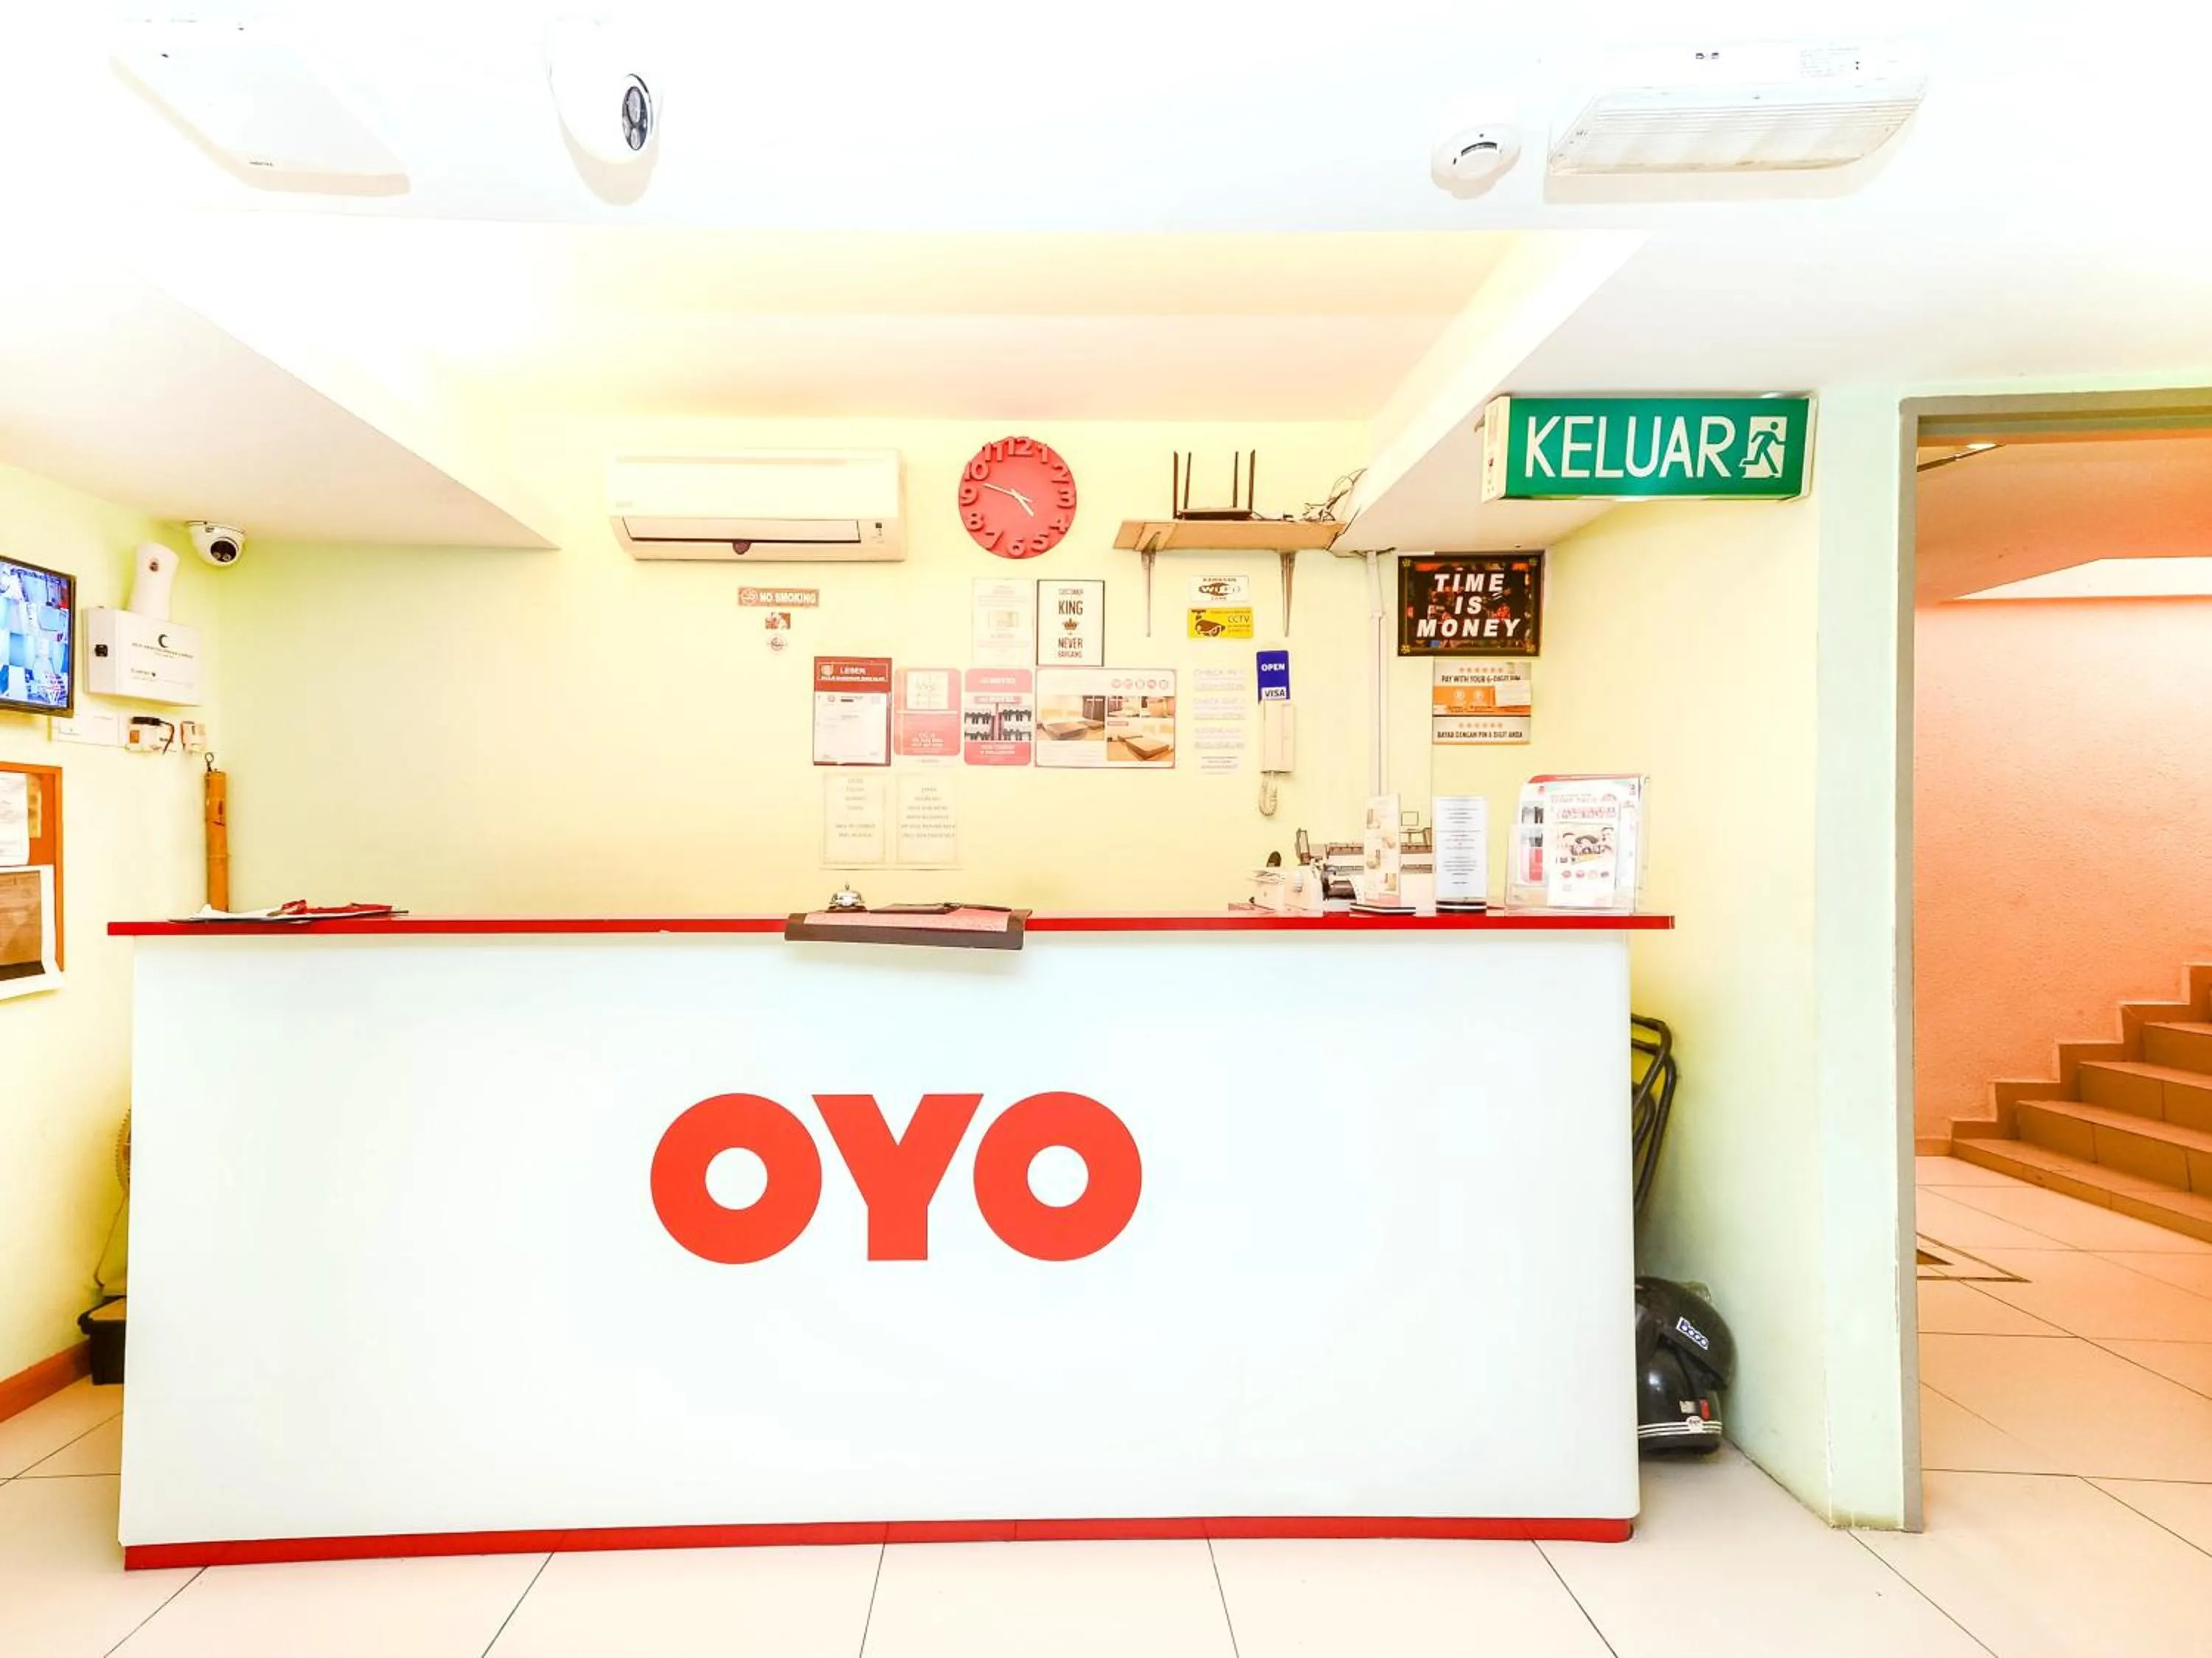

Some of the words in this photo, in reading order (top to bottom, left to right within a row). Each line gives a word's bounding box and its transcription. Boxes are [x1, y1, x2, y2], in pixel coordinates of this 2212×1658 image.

[983, 442, 1004, 462] 11
[1005, 437, 1033, 457] 12
[1525, 415, 1736, 478] KELUAR
[964, 461, 990, 482] 10
[1051, 462, 1070, 484] 2
[959, 485, 978, 507] 9
[1057, 488, 1074, 509] 3
[967, 510, 984, 532] 8
[1048, 515, 1068, 534] 4
[1007, 537, 1025, 558] 6
[1031, 532, 1049, 552] 5
[1434, 573, 1505, 592] TIME
[759, 592, 773, 602] NO
[775, 592, 816, 603] SMOKING
[1058, 600, 1083, 615] KING
[1454, 595, 1483, 614] IS
[1416, 619, 1521, 637] MONEY
[1058, 637, 1083, 649] NEVER
[1261, 662, 1285, 672] OPEN
[1470, 675, 1485, 683] YOUR
[1265, 689, 1285, 697] VISA
[650, 1092, 1142, 1264] OYO
